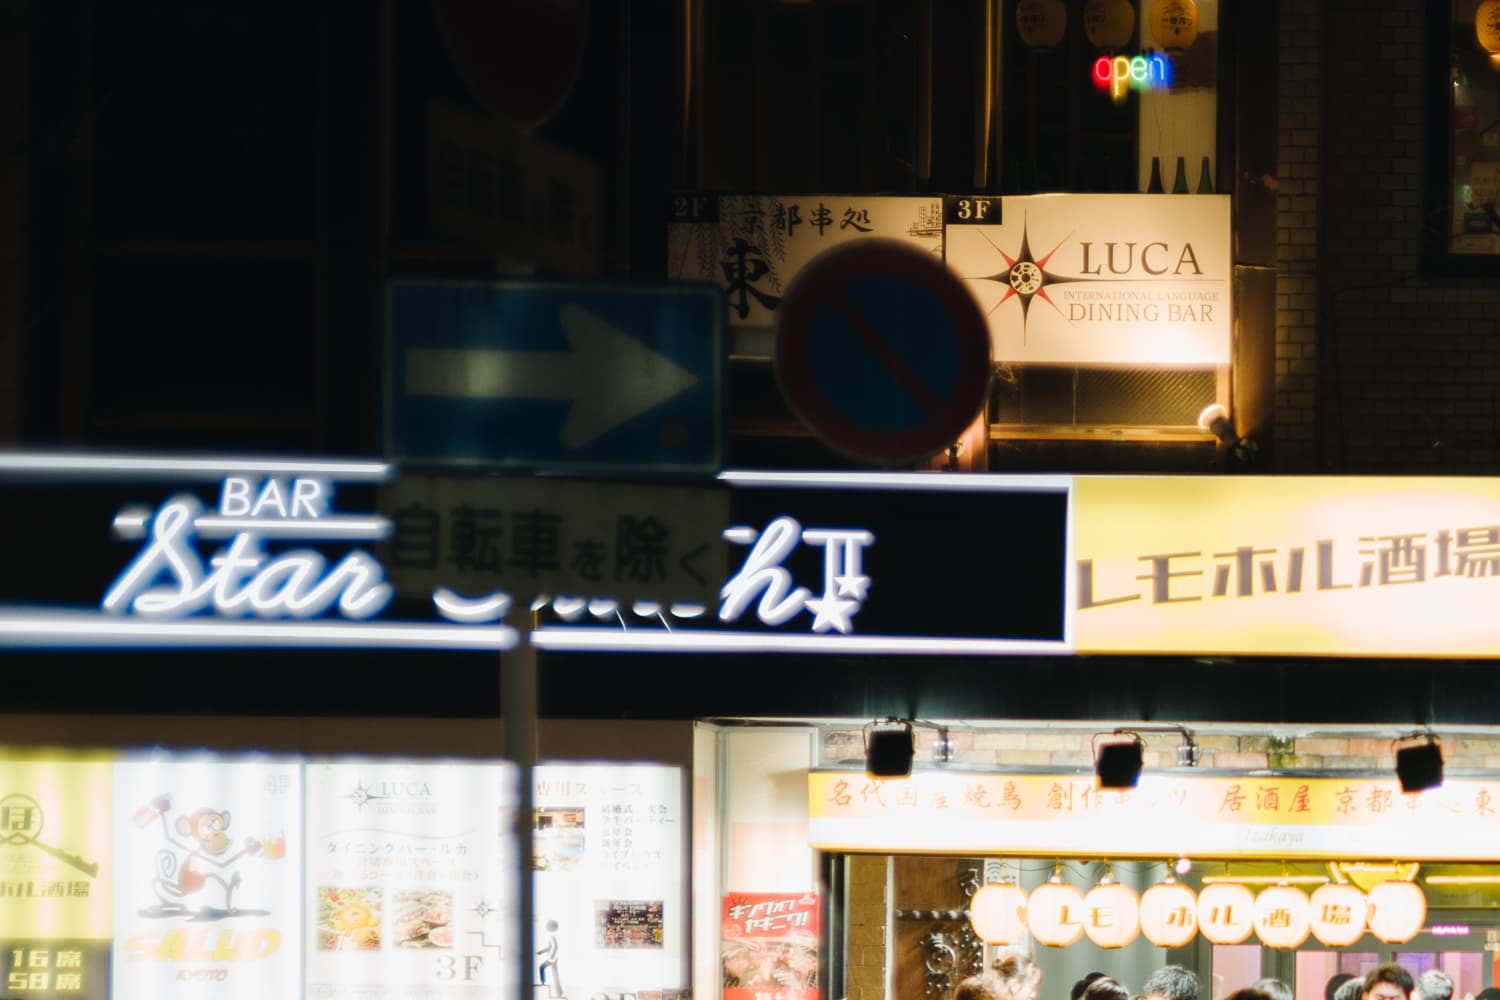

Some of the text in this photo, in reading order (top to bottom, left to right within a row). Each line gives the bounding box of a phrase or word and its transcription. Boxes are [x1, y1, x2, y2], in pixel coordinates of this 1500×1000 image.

[1094, 55, 1167, 98] open
[958, 200, 991, 220] 3F
[1079, 241, 1204, 276] LUCA
[1063, 290, 1219, 302] INTERNATIONAL LANGUAGE
[1069, 303, 1214, 323] DINING BAR
[221, 477, 322, 517] BAR
[104, 494, 391, 618] Star
[390, 502, 710, 587] 自転車を除く
[380, 781, 433, 797] LUCA
[434, 955, 485, 981] 3F
